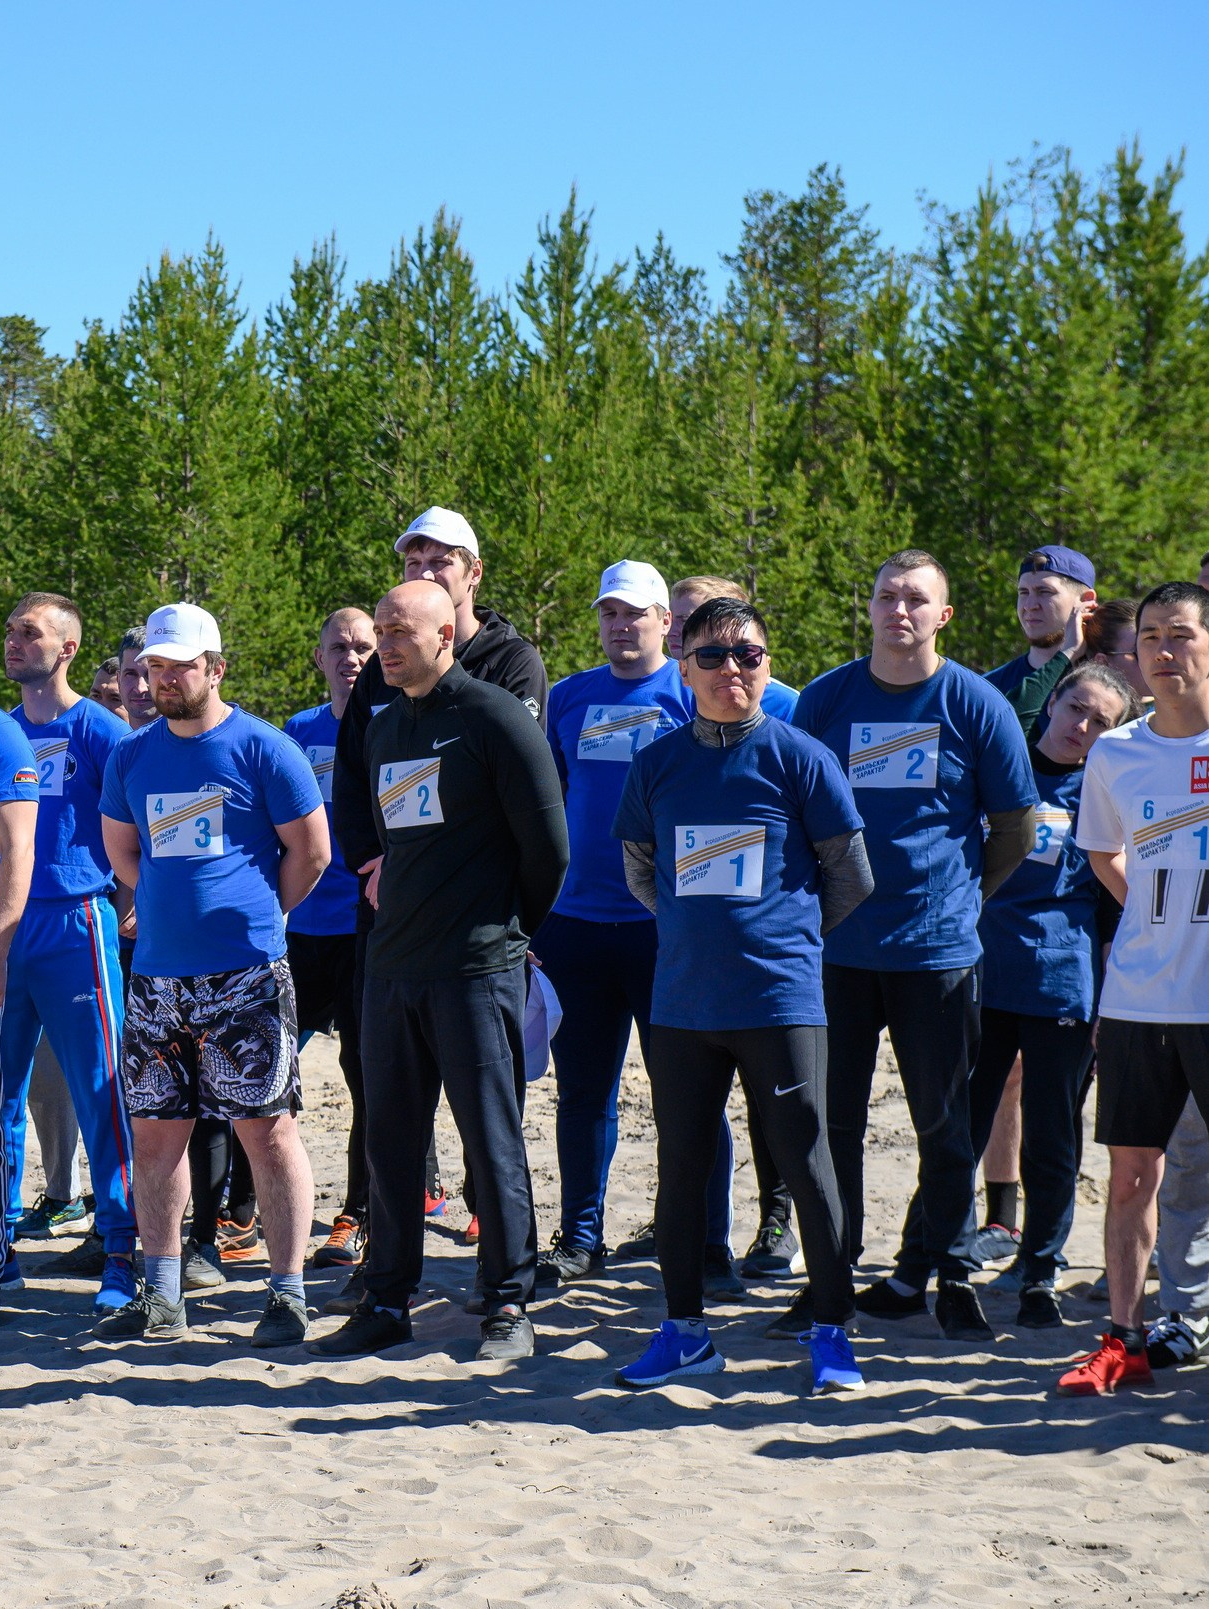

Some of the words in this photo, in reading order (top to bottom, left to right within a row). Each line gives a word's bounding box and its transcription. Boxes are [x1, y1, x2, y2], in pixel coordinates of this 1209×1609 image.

[594, 708, 603, 722] 4
[580, 733, 613, 747] ЯМАЛЬСКИЙ
[629, 728, 641, 755] 1
[861, 727, 872, 745] 5
[583, 740, 610, 752] ХАРАКТЕР
[852, 756, 889, 775] ЯМАЛЬСКИЙ
[856, 765, 886, 780] ХАРАКТЕР
[905, 748, 925, 780] 2
[38, 761, 54, 788] 2
[385, 767, 392, 784] 4
[154, 798, 164, 814] 4
[417, 785, 431, 817] 2
[1143, 800, 1154, 820] 6
[194, 817, 211, 848] 3
[685, 830, 696, 849] 5
[1033, 825, 1053, 854] 3
[1136, 833, 1173, 854] ЯМАЛЬСКИЙ
[1141, 843, 1170, 860] ХАРАКТЕР
[1193, 826, 1208, 860] 1
[678, 861, 711, 882] ЯМАЛЬСКИЙ
[681, 870, 709, 887] ХАРАКТЕР
[730, 854, 744, 887] 1
